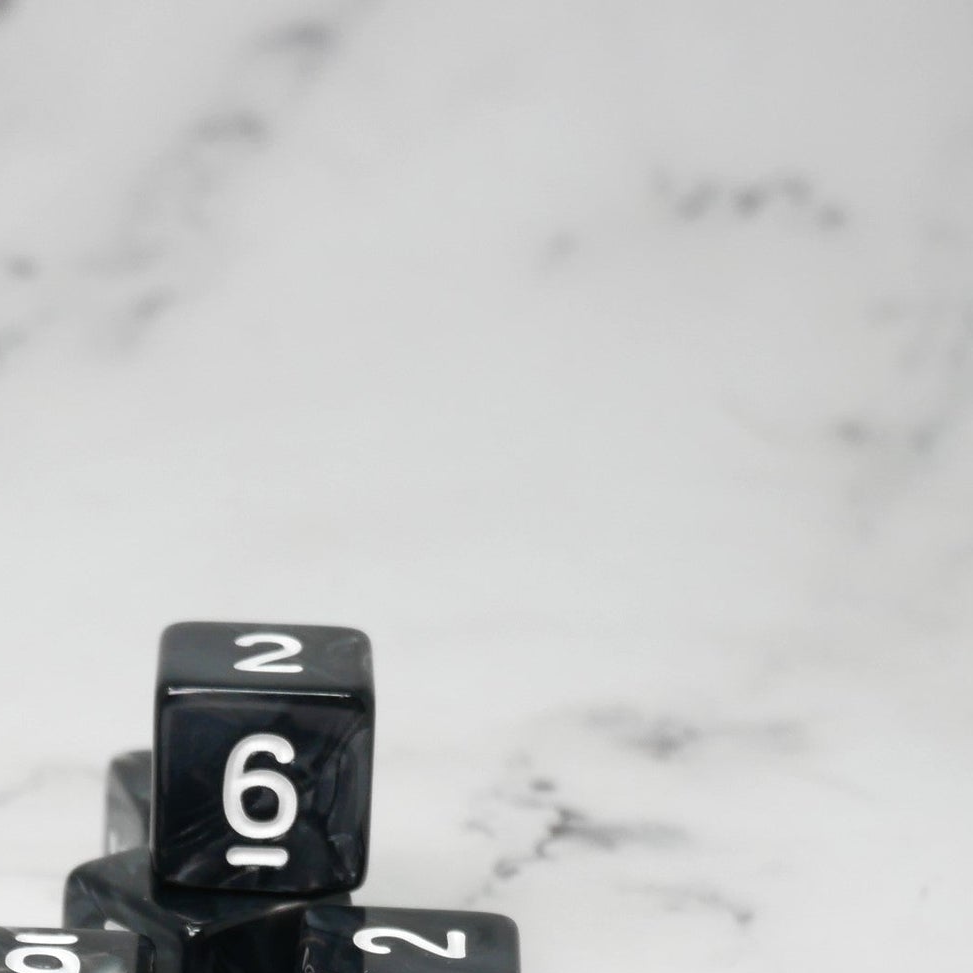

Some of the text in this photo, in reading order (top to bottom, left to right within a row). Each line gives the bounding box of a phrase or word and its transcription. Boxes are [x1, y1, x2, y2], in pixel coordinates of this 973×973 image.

[233, 632, 304, 674] 2
[222, 733, 298, 867] 6
[352, 926, 467, 960] 2
